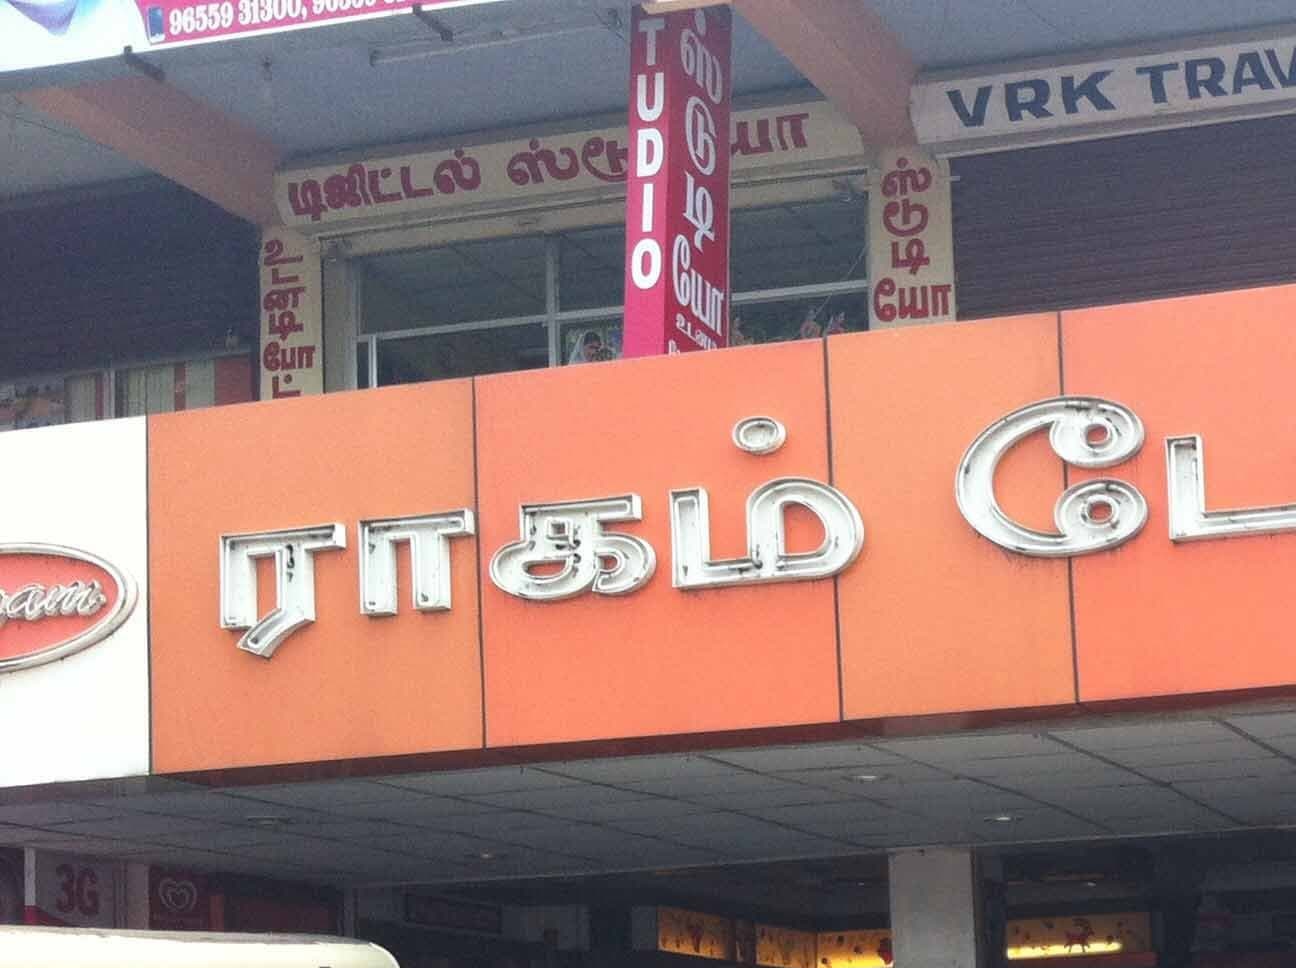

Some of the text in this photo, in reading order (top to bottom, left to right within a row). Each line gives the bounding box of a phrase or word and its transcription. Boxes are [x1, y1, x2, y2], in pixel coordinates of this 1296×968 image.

[169, 2, 234, 35] 96559
[946, 69, 1115, 128] VRK
[287, 148, 482, 222] டிஜிட்டல்
[219, 415, 866, 659] ராகம்
